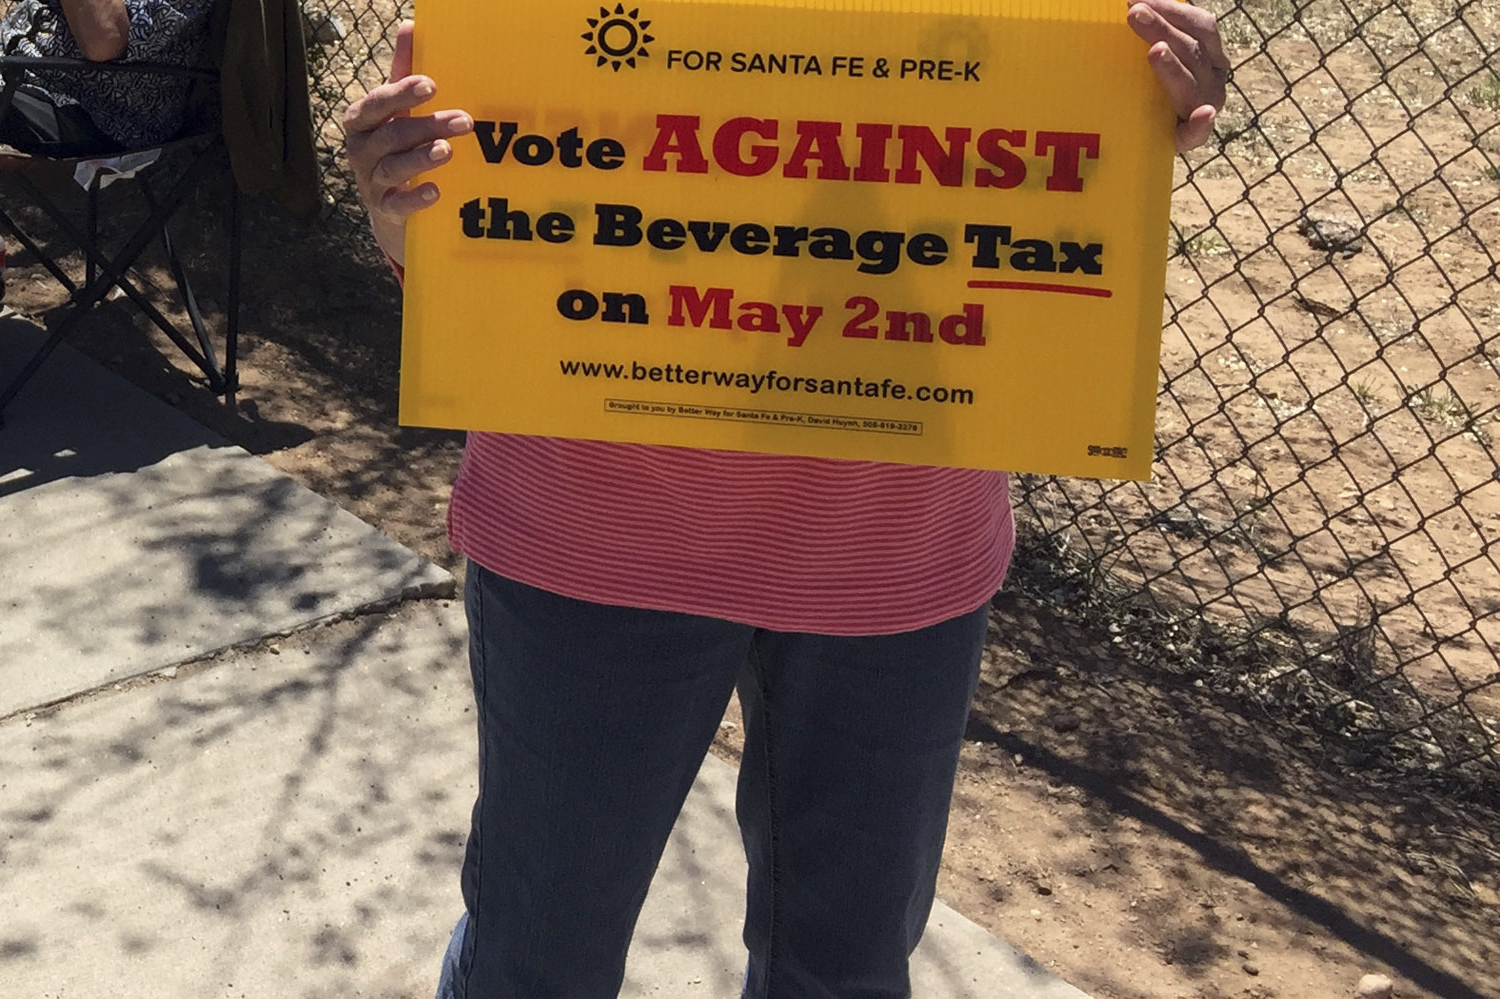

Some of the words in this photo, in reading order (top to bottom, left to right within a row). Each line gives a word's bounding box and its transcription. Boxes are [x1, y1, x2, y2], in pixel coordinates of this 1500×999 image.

[667, 49, 722, 72] FOR
[731, 52, 822, 76] SANTA
[832, 56, 864, 77] FE
[872, 57, 890, 78] &
[900, 59, 981, 82] PRE-K
[474, 120, 626, 170] Vote
[643, 114, 1100, 192] AGAINST
[459, 197, 575, 243] the
[593, 203, 948, 275] Beverage
[964, 223, 1103, 275] Tax
[557, 288, 649, 325] on
[667, 285, 823, 347] May
[842, 295, 986, 346] 2nd
[560, 359, 974, 405] www.betterwayforsantafe.com
[608, 401, 640, 411] Brought
[667, 405, 676, 414] by
[678, 406, 703, 416] Better
[705, 408, 721, 418] Way
[723, 409, 734, 417] for
[736, 410, 759, 419] Santa
[808, 416, 830, 425] David
